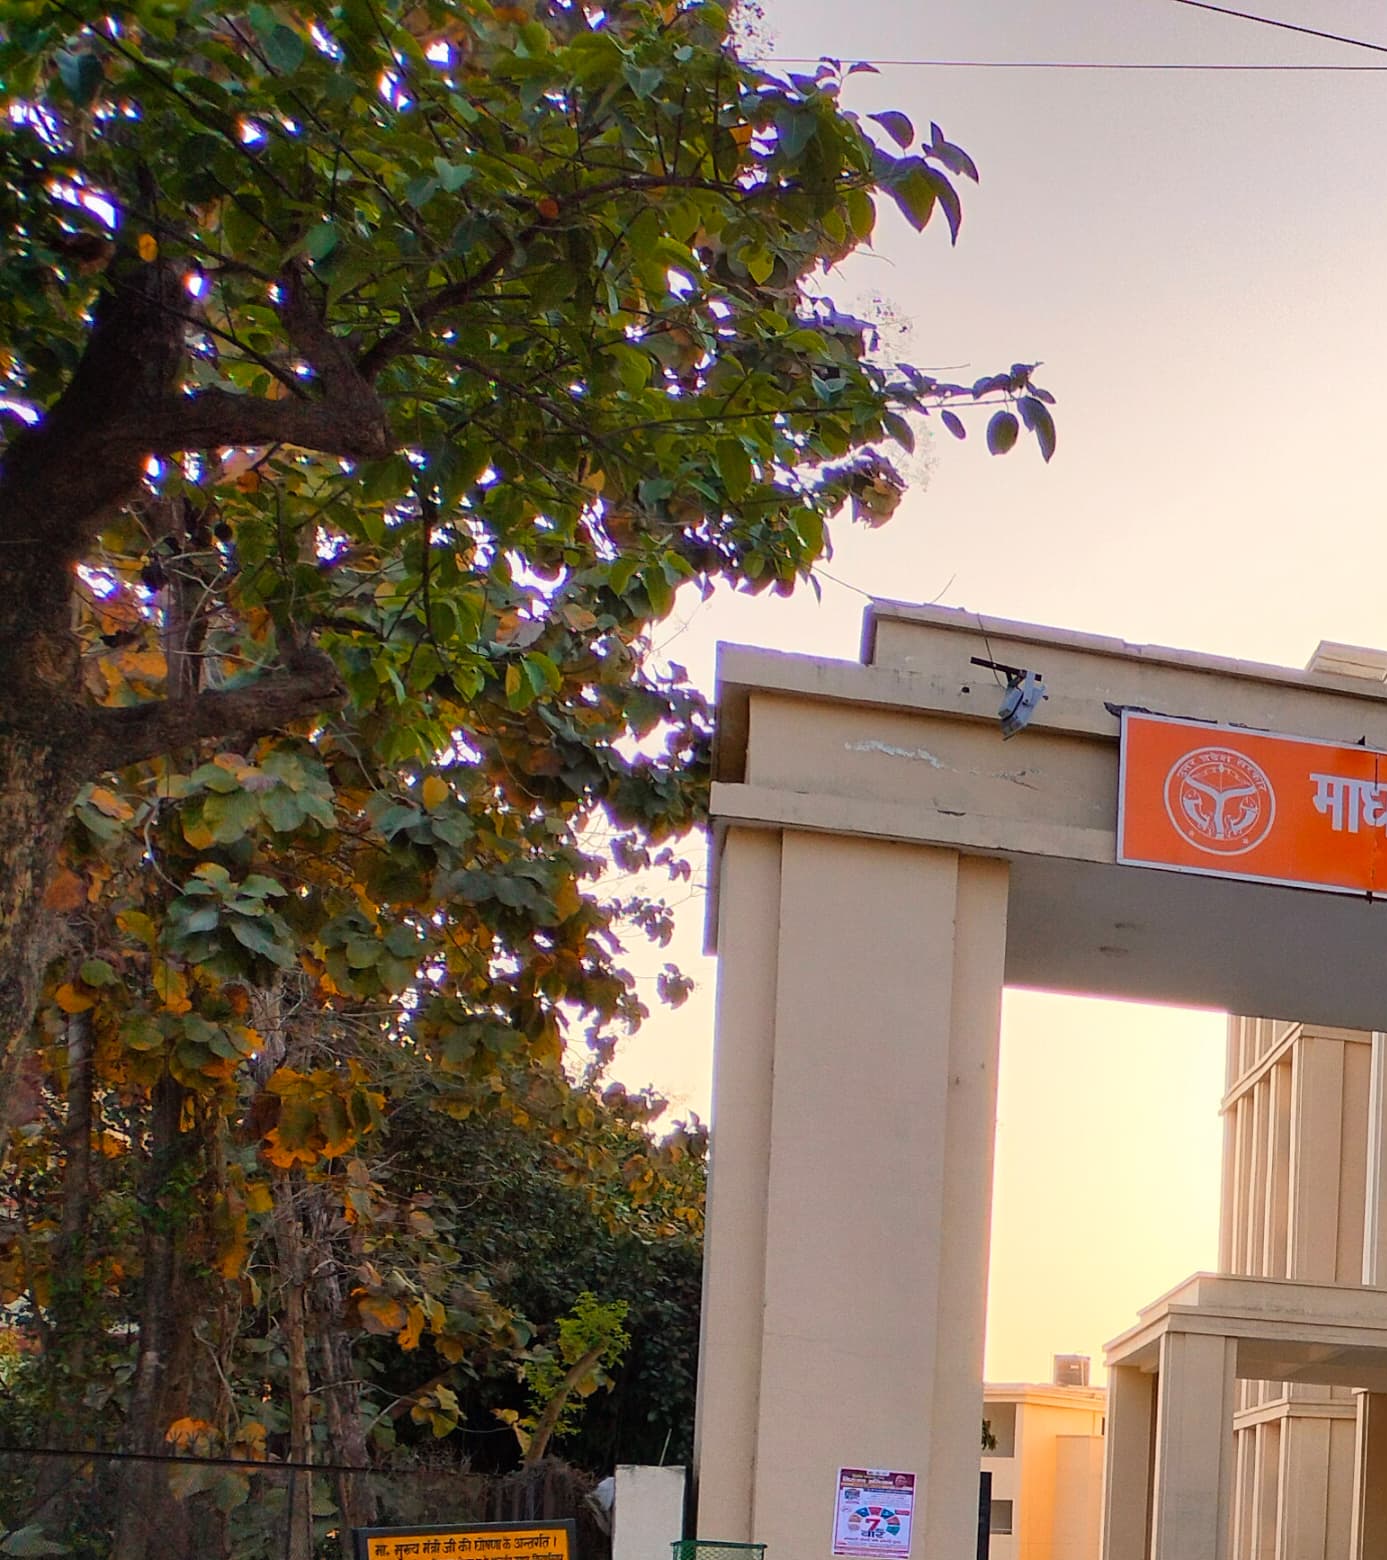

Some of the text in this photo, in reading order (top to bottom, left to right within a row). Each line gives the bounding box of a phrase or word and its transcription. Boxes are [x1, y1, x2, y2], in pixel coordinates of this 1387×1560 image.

[864, 1518, 881, 1531] 7
[442, 1537, 457, 1553] जी
[458, 1537, 472, 1552] की
